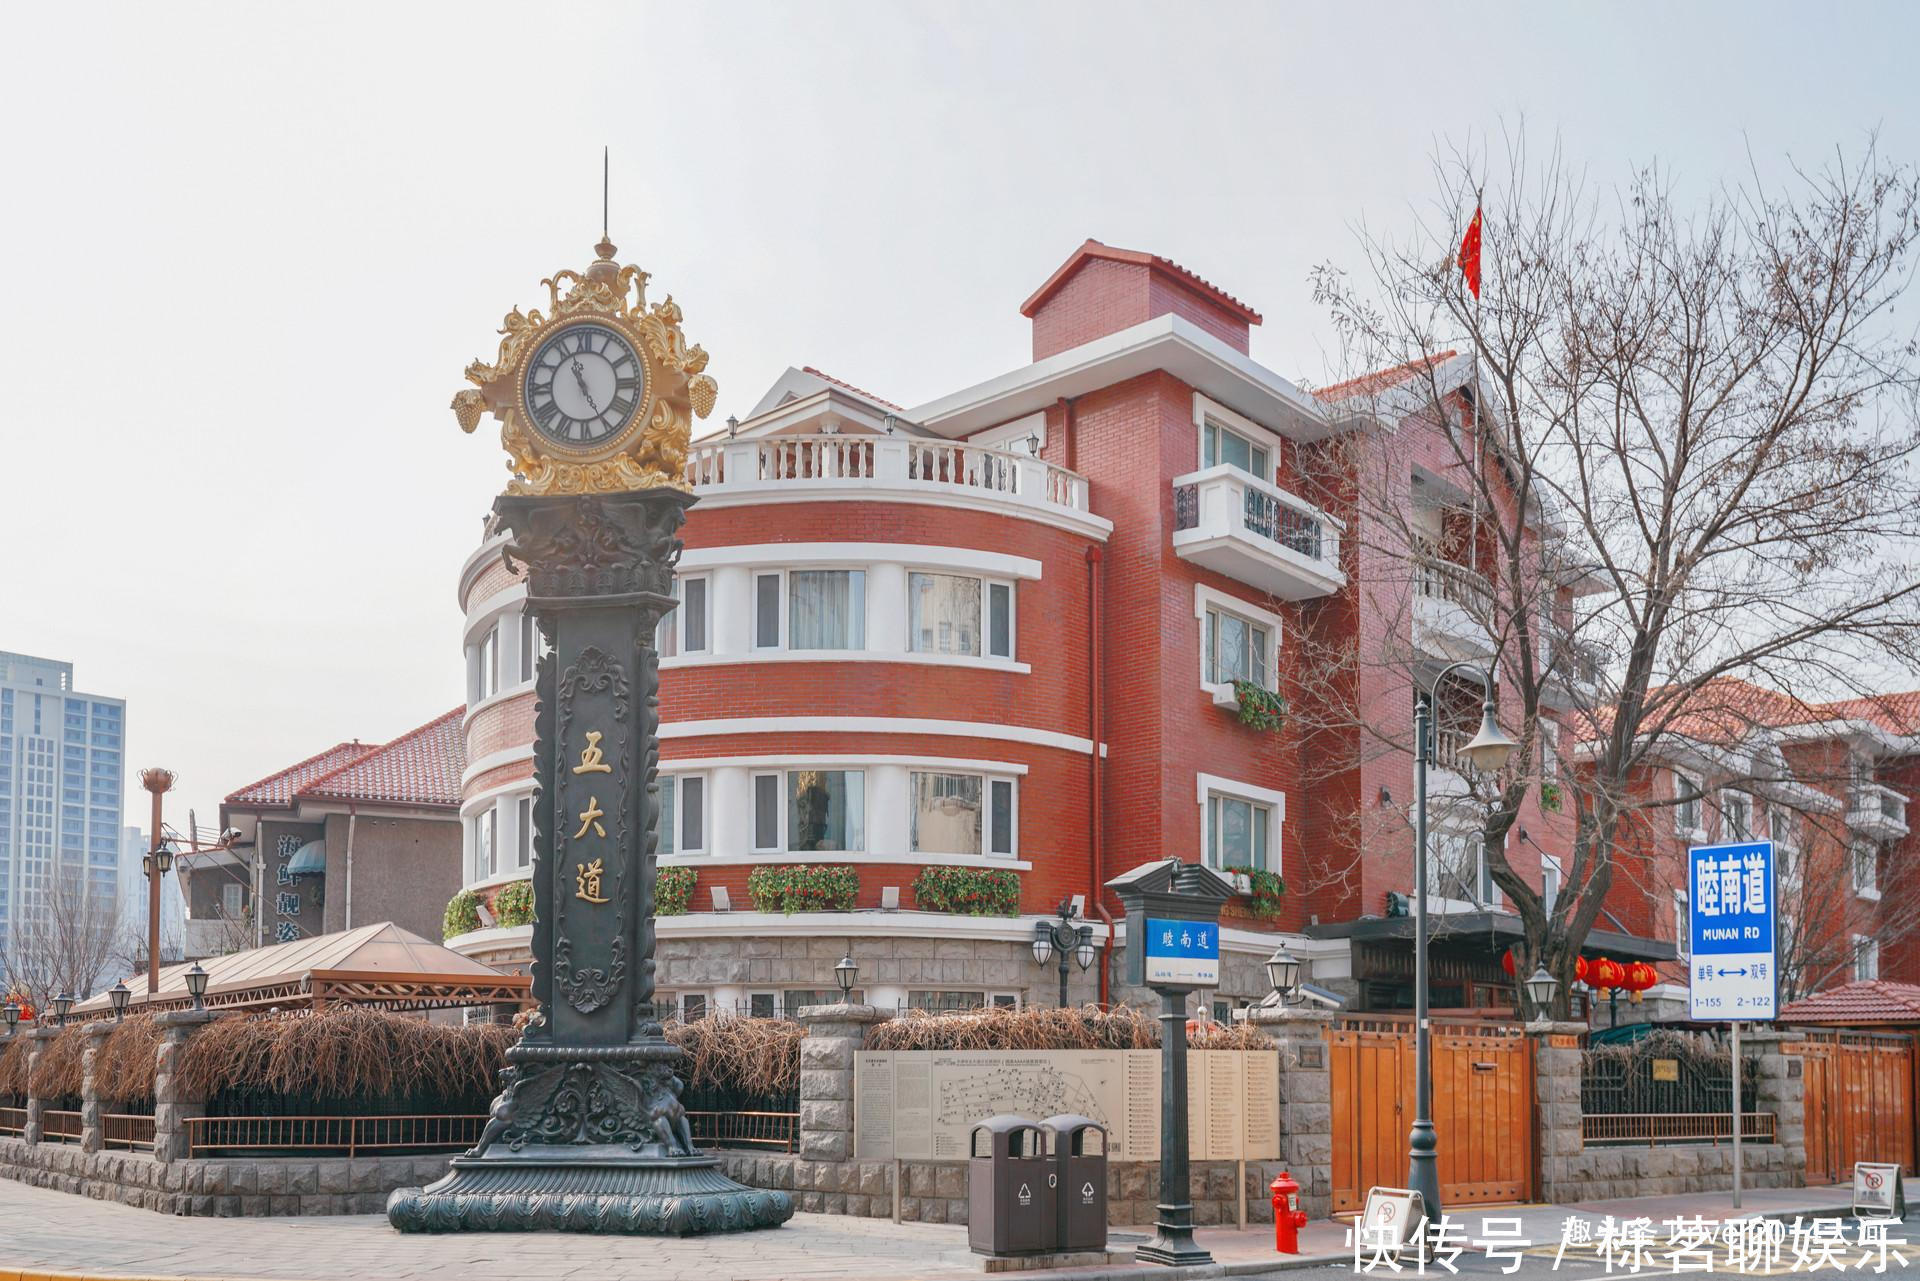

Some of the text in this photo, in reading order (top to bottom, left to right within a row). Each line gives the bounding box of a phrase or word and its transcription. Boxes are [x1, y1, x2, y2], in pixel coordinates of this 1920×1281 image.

[572, 731, 612, 904] 五大道
[1696, 852, 1766, 916] 睦南道
[1162, 929, 1209, 949] 睦南道
[1703, 926, 1760, 940] MUNAN RD
[1697, 963, 1767, 981] 单号 双号
[1695, 997, 1770, 1008] 1-155 2-122
